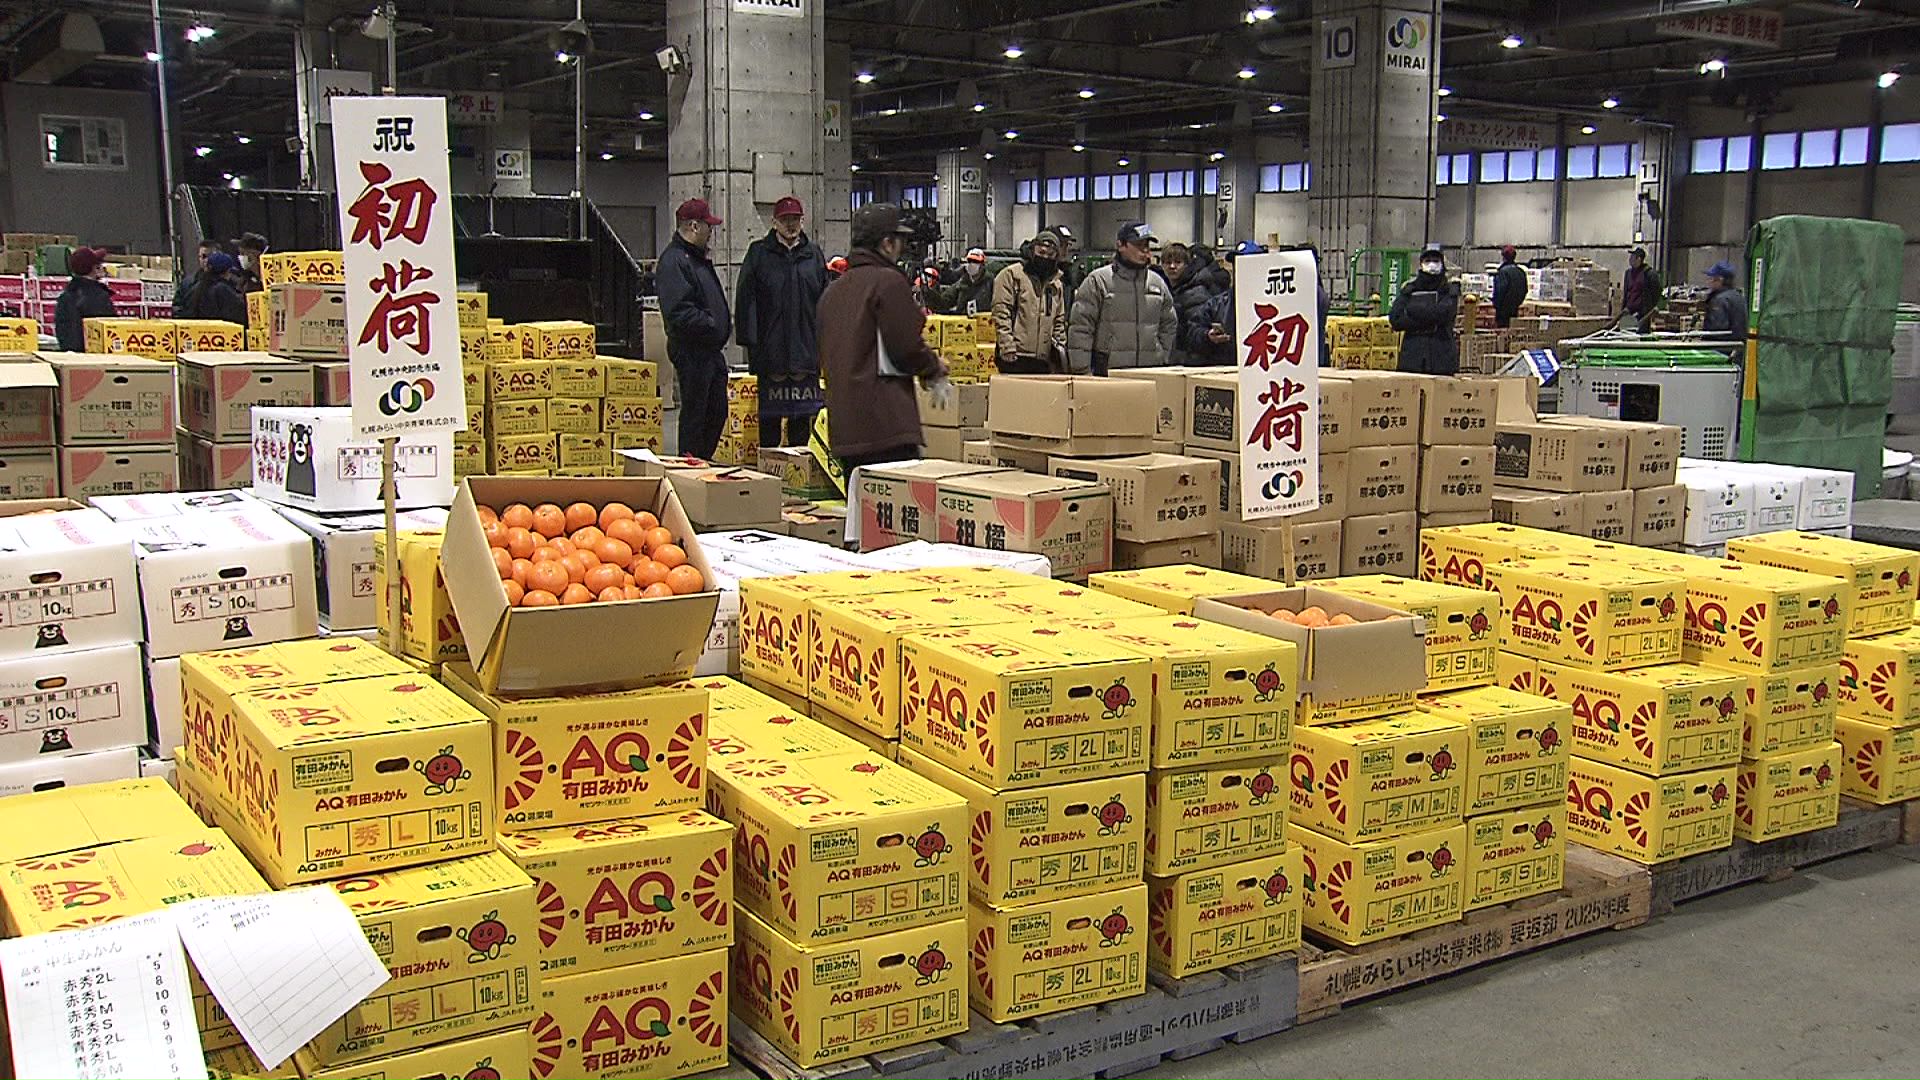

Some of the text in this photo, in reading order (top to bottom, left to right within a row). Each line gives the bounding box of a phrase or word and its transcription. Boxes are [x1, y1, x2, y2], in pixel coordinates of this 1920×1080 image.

[1325, 27, 1353, 59] 10
[1386, 54, 1424, 70] MIRAI
[373, 117, 415, 152] 祝
[496, 169, 522, 177] MIRAI
[1642, 164, 1657, 179] 11
[1220, 184, 1232, 197] 12
[306, 262, 336, 277] AQ
[347, 160, 441, 357] 初荷
[1265, 266, 1296, 295] 祝
[126, 334, 156, 347] AQ
[198, 334, 226, 347] AQ
[509, 373, 536, 386] AQ
[1243, 302, 1309, 453] 初荷
[768, 387, 818, 401] MIRAI
[1390, 415, 1408, 428] 天草
[1469, 417, 1487, 429] 天草
[514, 445, 541, 459] AQ
[863, 484, 893, 497] くまもと
[1387, 484, 1405, 497] 天草
[940, 497, 975, 514] くまもと
[1156, 504, 1208, 521] 熊本 天草
[1443, 554, 1484, 586] AQ
[359, 577, 374, 593] 秀
[181, 602, 195, 617] 秀
[208, 596, 223, 609] S
[1511, 593, 1564, 632] AQ
[755, 610, 785, 652] AQ
[1511, 623, 1562, 647] 有田みかん
[829, 638, 863, 686] AQ
[1454, 653, 1467, 671] S
[828, 674, 863, 704] 有田みかん
[926, 678, 968, 732] AQ
[1572, 692, 1622, 734] AQ
[194, 701, 217, 757] AQ
[926, 717, 968, 751] 有田みかん
[562, 731, 651, 780] AQ
[1050, 738, 1099, 762] 秀 2L
[295, 759, 350, 776] 有田みかん
[562, 776, 650, 800] 有田みかん
[315, 790, 408, 813] AQ有田みかん
[1567, 778, 1614, 823] AQ
[354, 824, 381, 848] 秀
[397, 821, 415, 842] L
[1041, 854, 1090, 878] 秀 2L
[584, 870, 676, 925] AQ
[855, 888, 909, 917] 秀 S
[584, 916, 676, 946] 有田みかん
[1509, 911, 1559, 946] 要返却
[1564, 893, 1632, 930] 2025年度
[1045, 968, 1093, 992] 秀 2L
[154, 988, 171, 1002] 10
[393, 998, 421, 1025] 秀
[439, 992, 457, 1015] L
[581, 996, 673, 1054] AQ
[857, 1007, 911, 1036] 秀 S
[582, 1040, 672, 1073] 有田みかん
